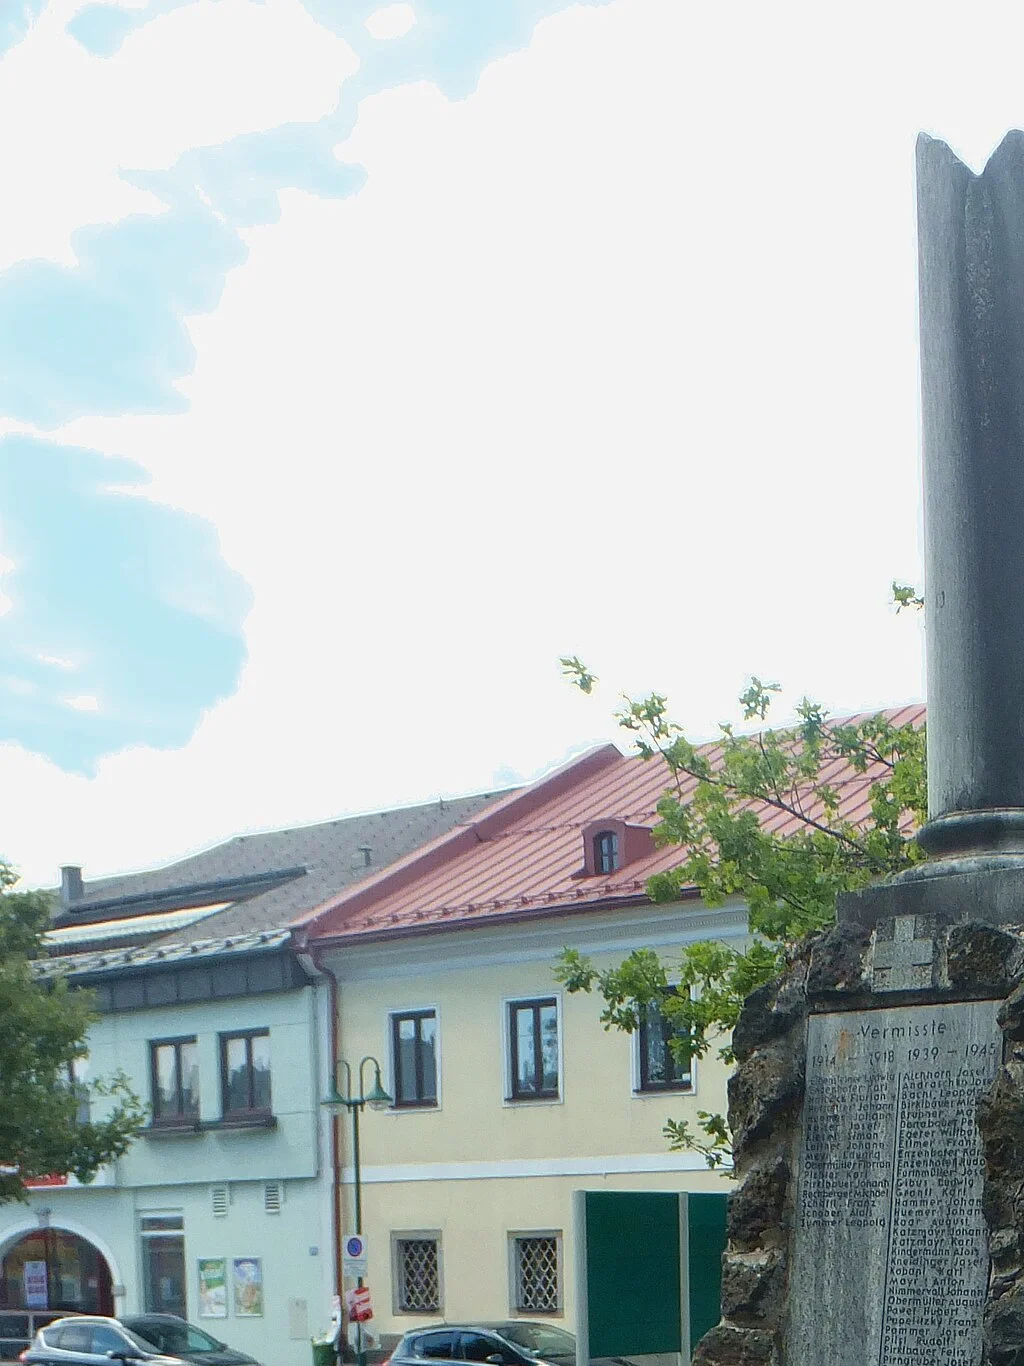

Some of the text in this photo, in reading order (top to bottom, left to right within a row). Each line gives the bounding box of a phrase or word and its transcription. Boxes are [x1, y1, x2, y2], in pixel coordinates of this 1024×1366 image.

[860, 1020, 947, 1039] Vermisste
[908, 1046, 939, 1062] 1939
[965, 1042, 996, 1058] 1945
[812, 1054, 836, 1068] 1914
[870, 1050, 895, 1066] 1918
[903, 1066, 986, 1081] Aichhorn Josef
[971, 1077, 993, 1086] Jose
[850, 1093, 886, 1102] Florian
[858, 1103, 894, 1111] Johann
[855, 1112, 891, 1121] Johann
[850, 1121, 878, 1130] Josef
[848, 1132, 879, 1140] Simon
[846, 1141, 885, 1150] Johann
[947, 1137, 977, 1147] Franz
[858, 1160, 891, 1168] Florian
[960, 1157, 986, 1166] Rudo
[847, 1170, 868, 1179] Karl
[856, 1180, 889, 1189] Johann
[938, 1177, 974, 1188] Ludwig
[942, 1186, 966, 1197] Karl
[847, 1199, 876, 1208] Franz
[895, 1198, 942, 1207] Hammer
[895, 1208, 937, 1217] Huemer
[846, 1218, 886, 1228] Leopold
[931, 1217, 969, 1228] August
[949, 1227, 990, 1237] Johann
[951, 1237, 974, 1247] Karl
[891, 1247, 980, 1258] Kindermann Alois
[890, 1257, 984, 1268] Kneidinger Josef
[937, 1267, 963, 1276] Karl
[889, 1277, 965, 1287] Mayr Anton
[947, 1287, 984, 1297] Johann
[948, 1299, 983, 1309] August
[923, 1307, 959, 1317] Hubert
[948, 1317, 977, 1328] Franz
[885, 1325, 969, 1338] Pammer Josef
[916, 1336, 951, 1346] Rudolf
[884, 1345, 967, 1357] Pirklbauer Felix
[883, 1355, 941, 1366] Pirngruber
